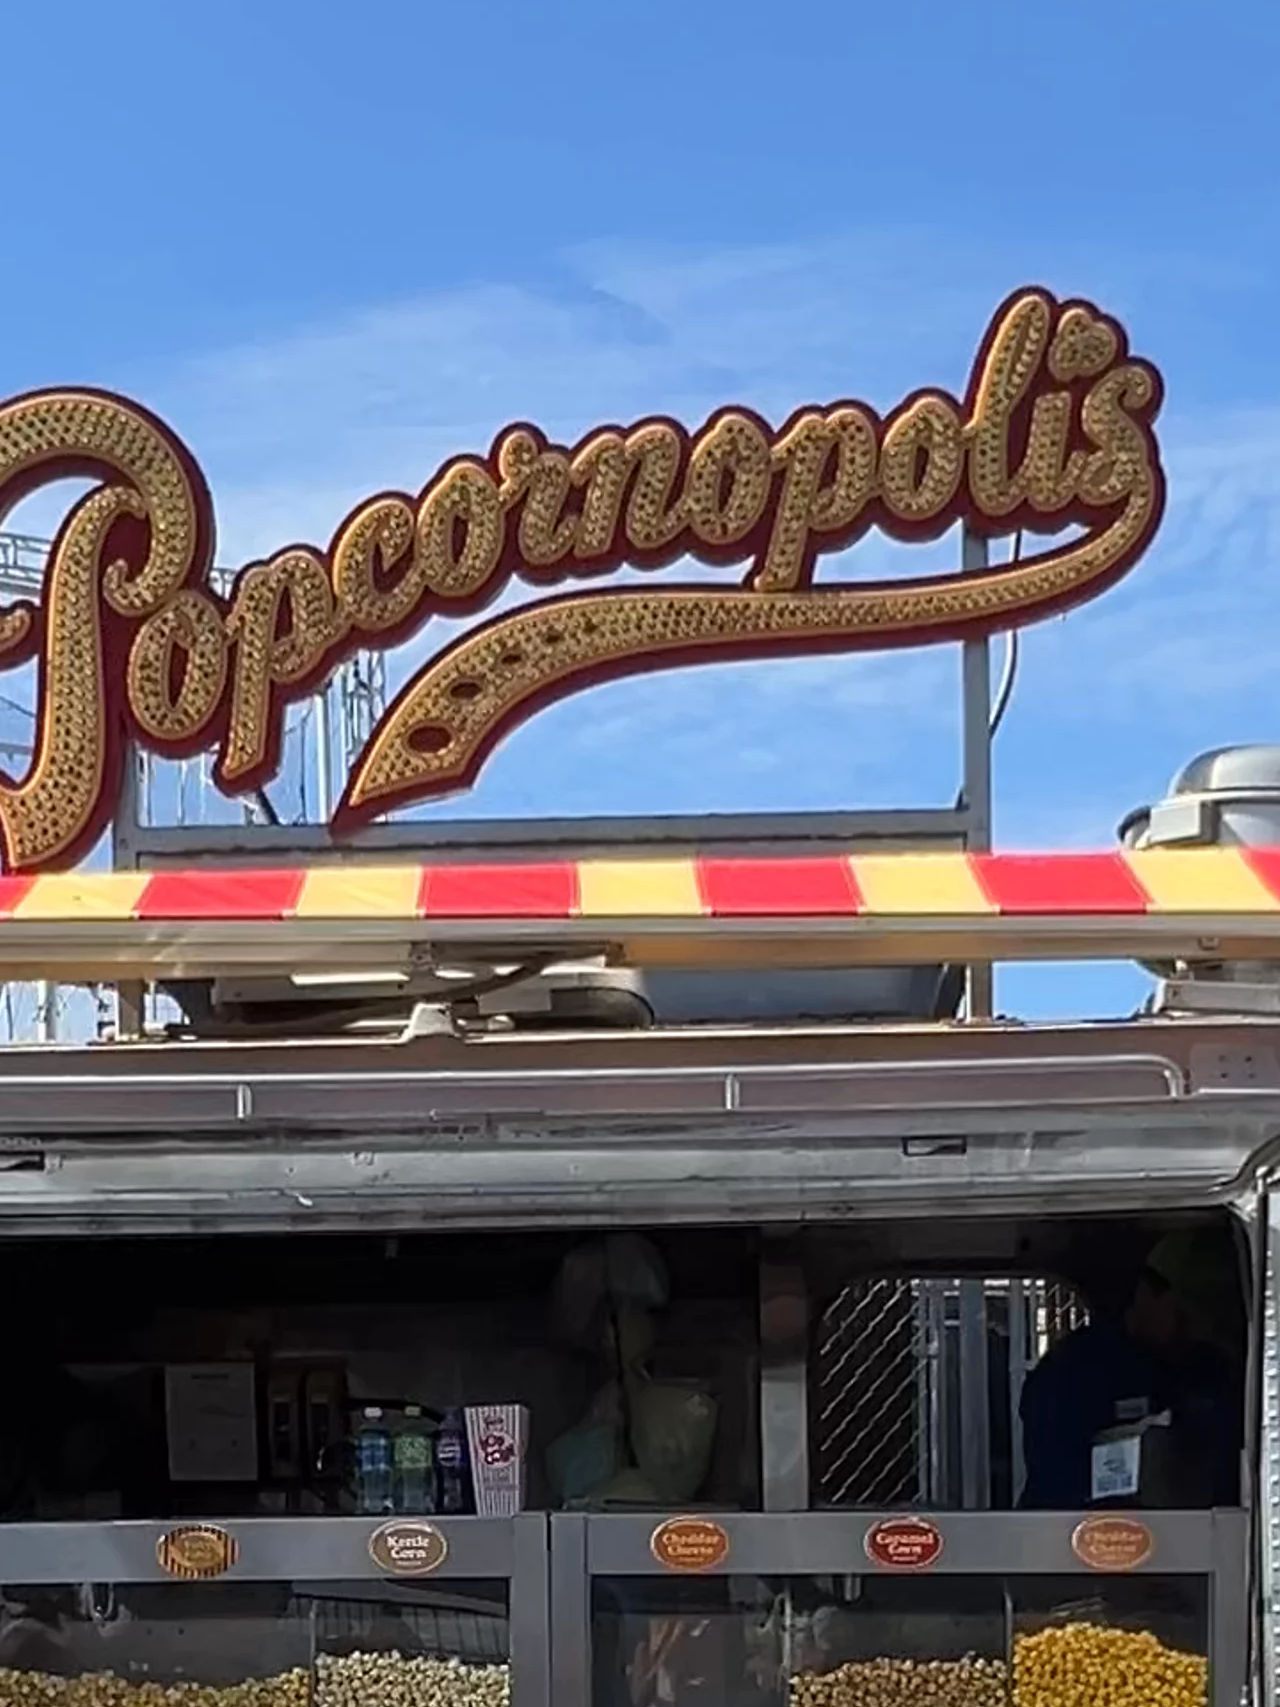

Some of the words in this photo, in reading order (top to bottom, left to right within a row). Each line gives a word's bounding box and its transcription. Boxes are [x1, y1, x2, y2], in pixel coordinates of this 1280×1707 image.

[386, 1536, 430, 1547] Kettle
[662, 1532, 720, 1544] Cheddar
[875, 1532, 934, 1544] Caramel
[390, 1547, 427, 1559] Corn
[888, 1544, 922, 1555] Corn
